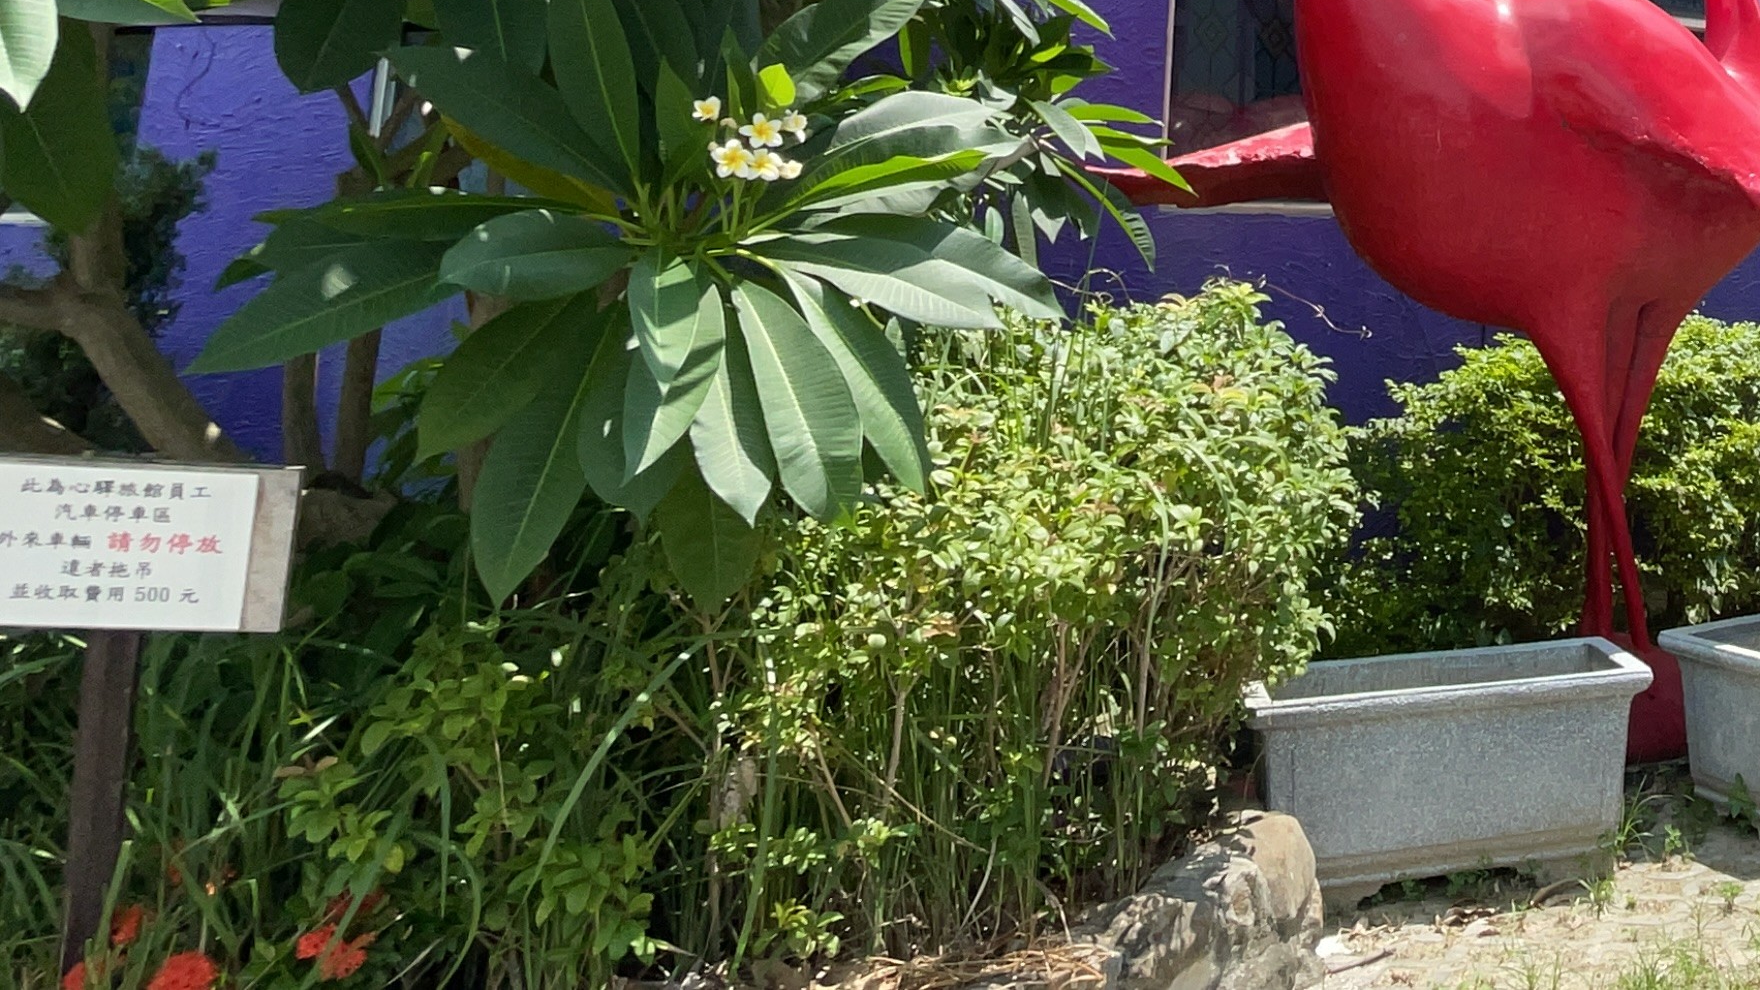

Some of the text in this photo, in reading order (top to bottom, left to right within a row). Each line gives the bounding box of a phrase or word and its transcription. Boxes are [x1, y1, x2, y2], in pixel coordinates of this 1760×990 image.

[55, 503, 171, 523] 汽車停車區
[107, 530, 223, 555] 請勿停放
[60, 559, 152, 580] 違者拖吊
[134, 586, 170, 603] 500
[178, 588, 200, 604] 元
